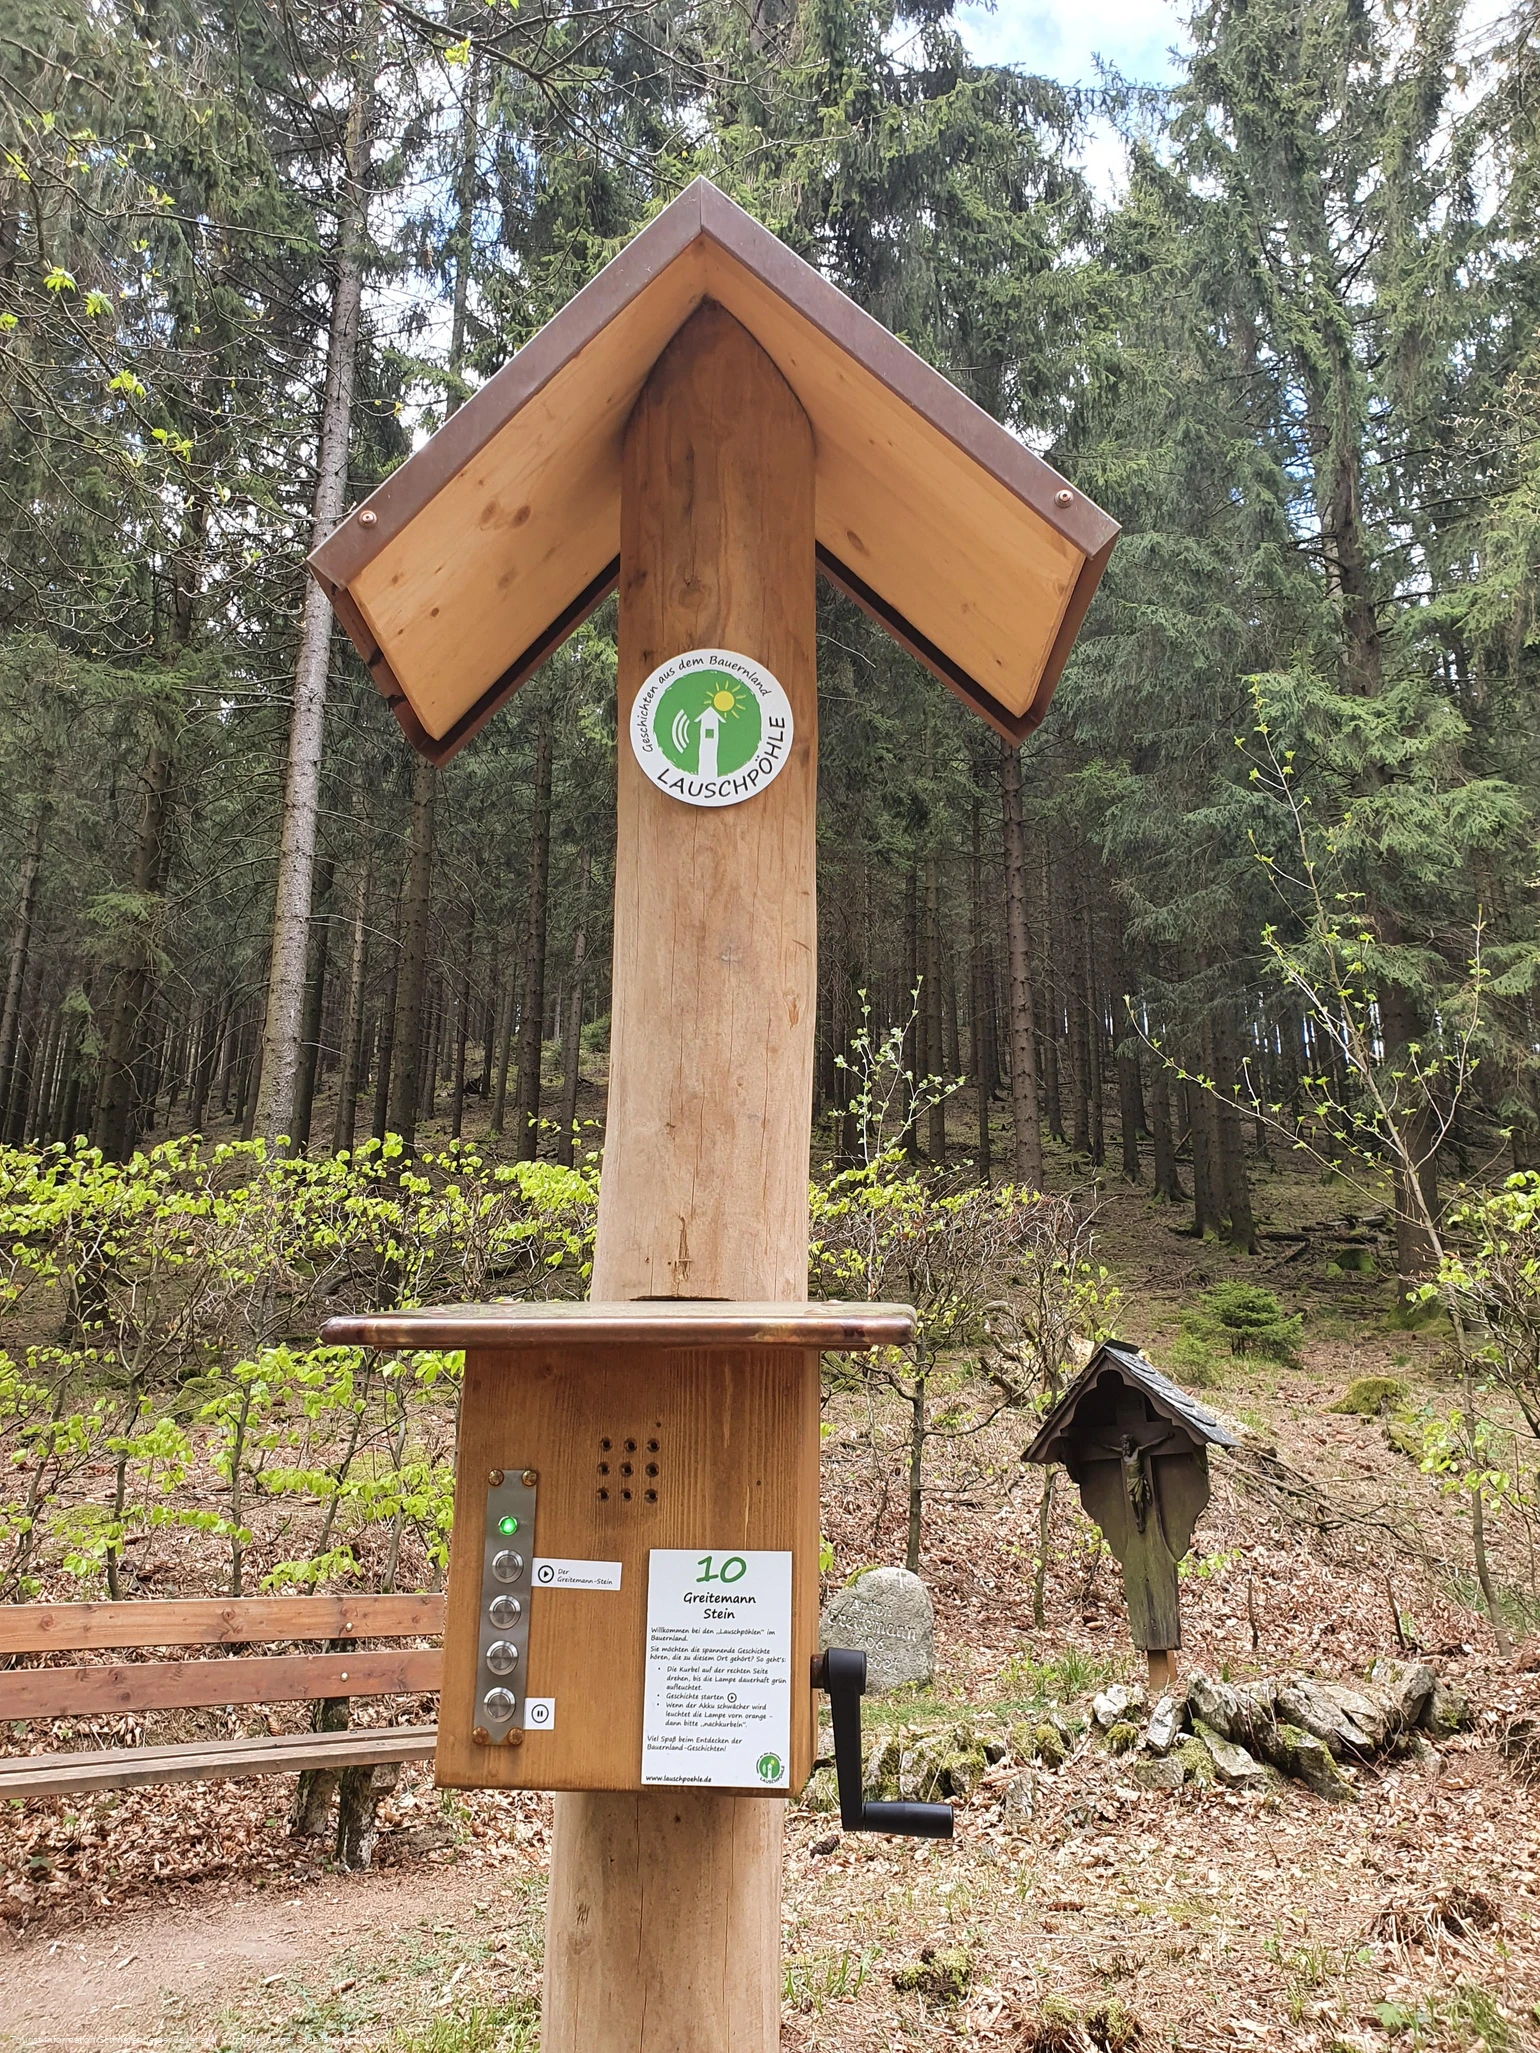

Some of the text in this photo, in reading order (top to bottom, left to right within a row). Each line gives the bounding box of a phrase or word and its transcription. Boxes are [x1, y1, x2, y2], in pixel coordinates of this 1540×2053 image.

[637, 656, 772, 752] Geschichten aus dem Bauernland
[657, 716, 785, 798] LAUSCHPÖHLE
[696, 1556, 746, 1583] 10
[557, 1576, 612, 1585] Greitemann-Stein
[683, 1592, 756, 1604] Greitemann
[704, 1608, 735, 1619] Stein
[702, 1647, 735, 1655] spannende
[715, 1676, 736, 1684] Lampe
[661, 1736, 676, 1744] Spaß
[647, 1744, 726, 1752] Bauernland-Geschichten!
[646, 1775, 711, 1783] www.lauschpoehle.de
